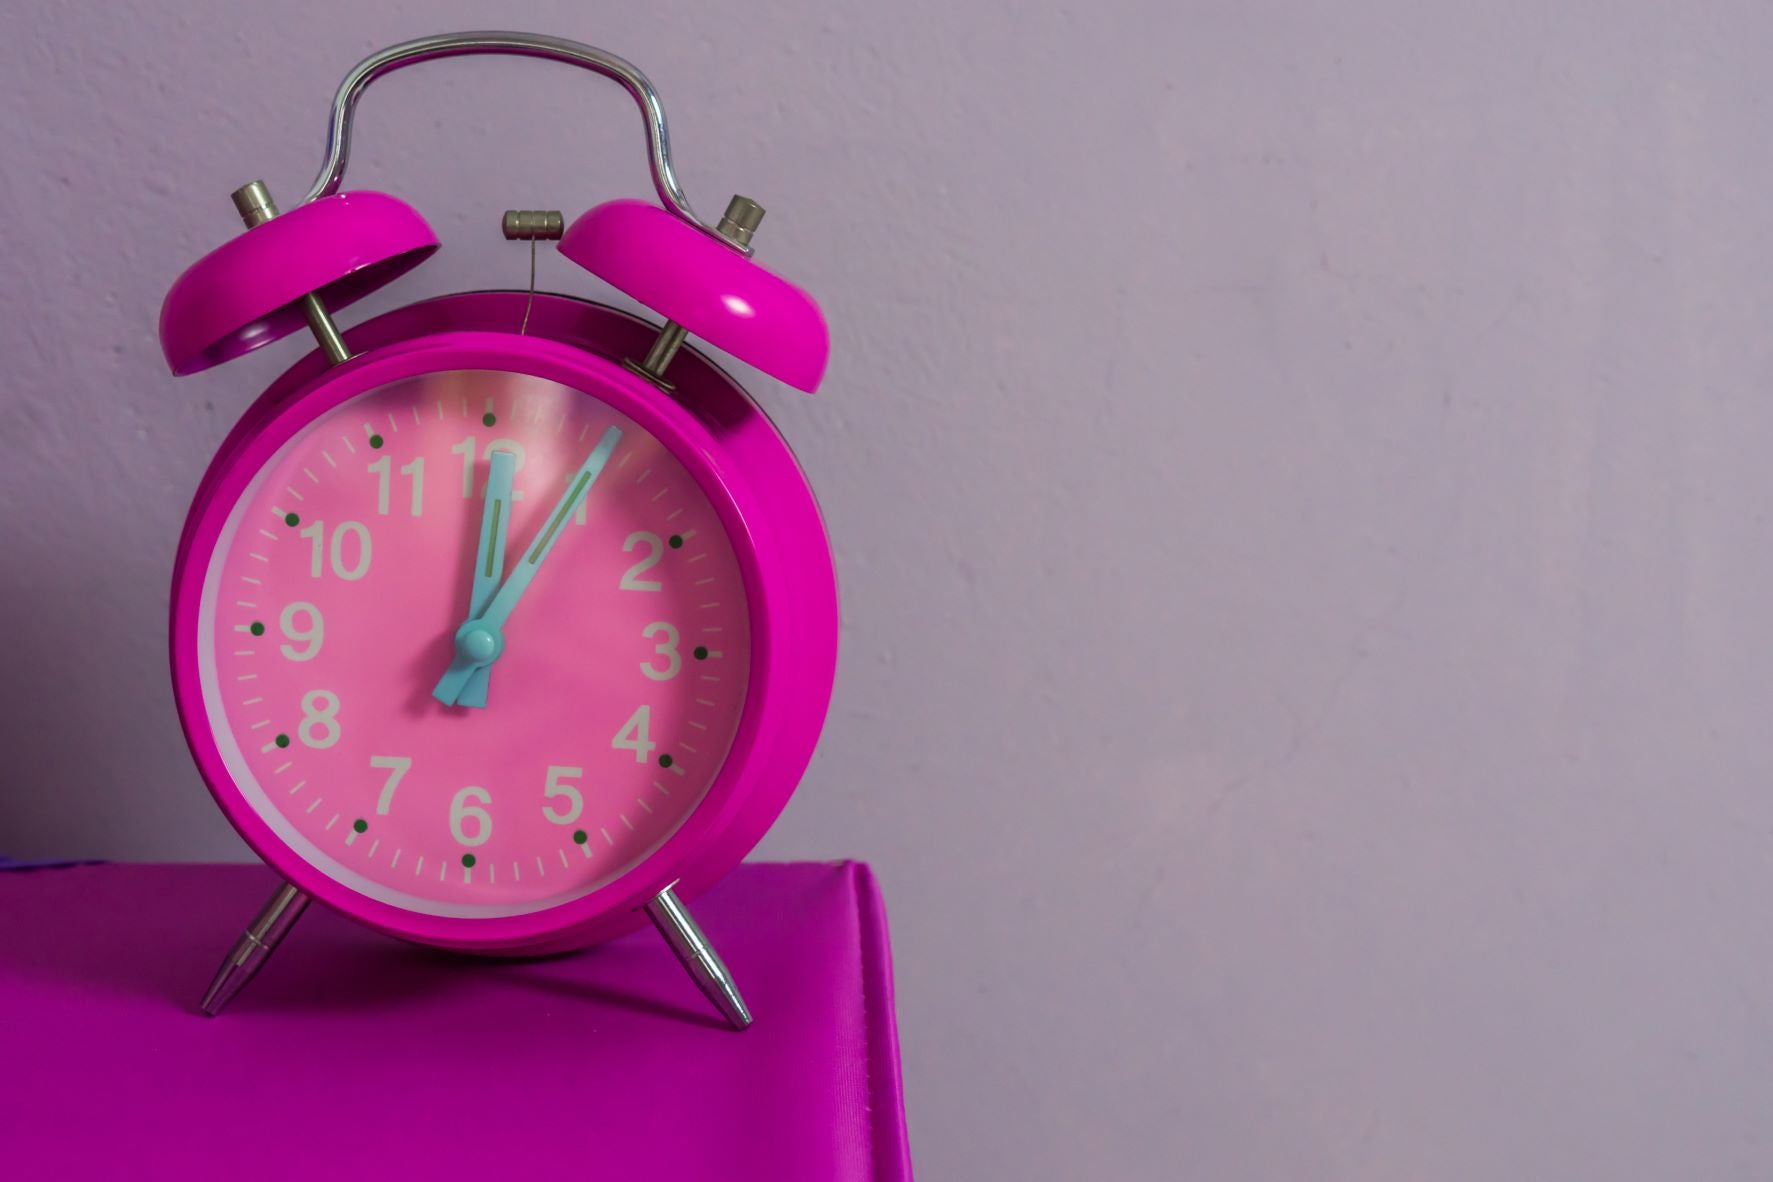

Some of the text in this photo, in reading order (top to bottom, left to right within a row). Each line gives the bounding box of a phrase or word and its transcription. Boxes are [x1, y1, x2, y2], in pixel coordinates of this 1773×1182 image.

[367, 455, 426, 518] 11
[299, 520, 373, 581] 10
[619, 530, 664, 593] 2
[279, 601, 324, 662] 9
[639, 620, 682, 682] 3
[297, 689, 342, 749] 8
[611, 704, 657, 764] 4
[369, 755, 413, 816] 7
[541, 765, 585, 826] 5
[448, 786, 493, 847] 6
